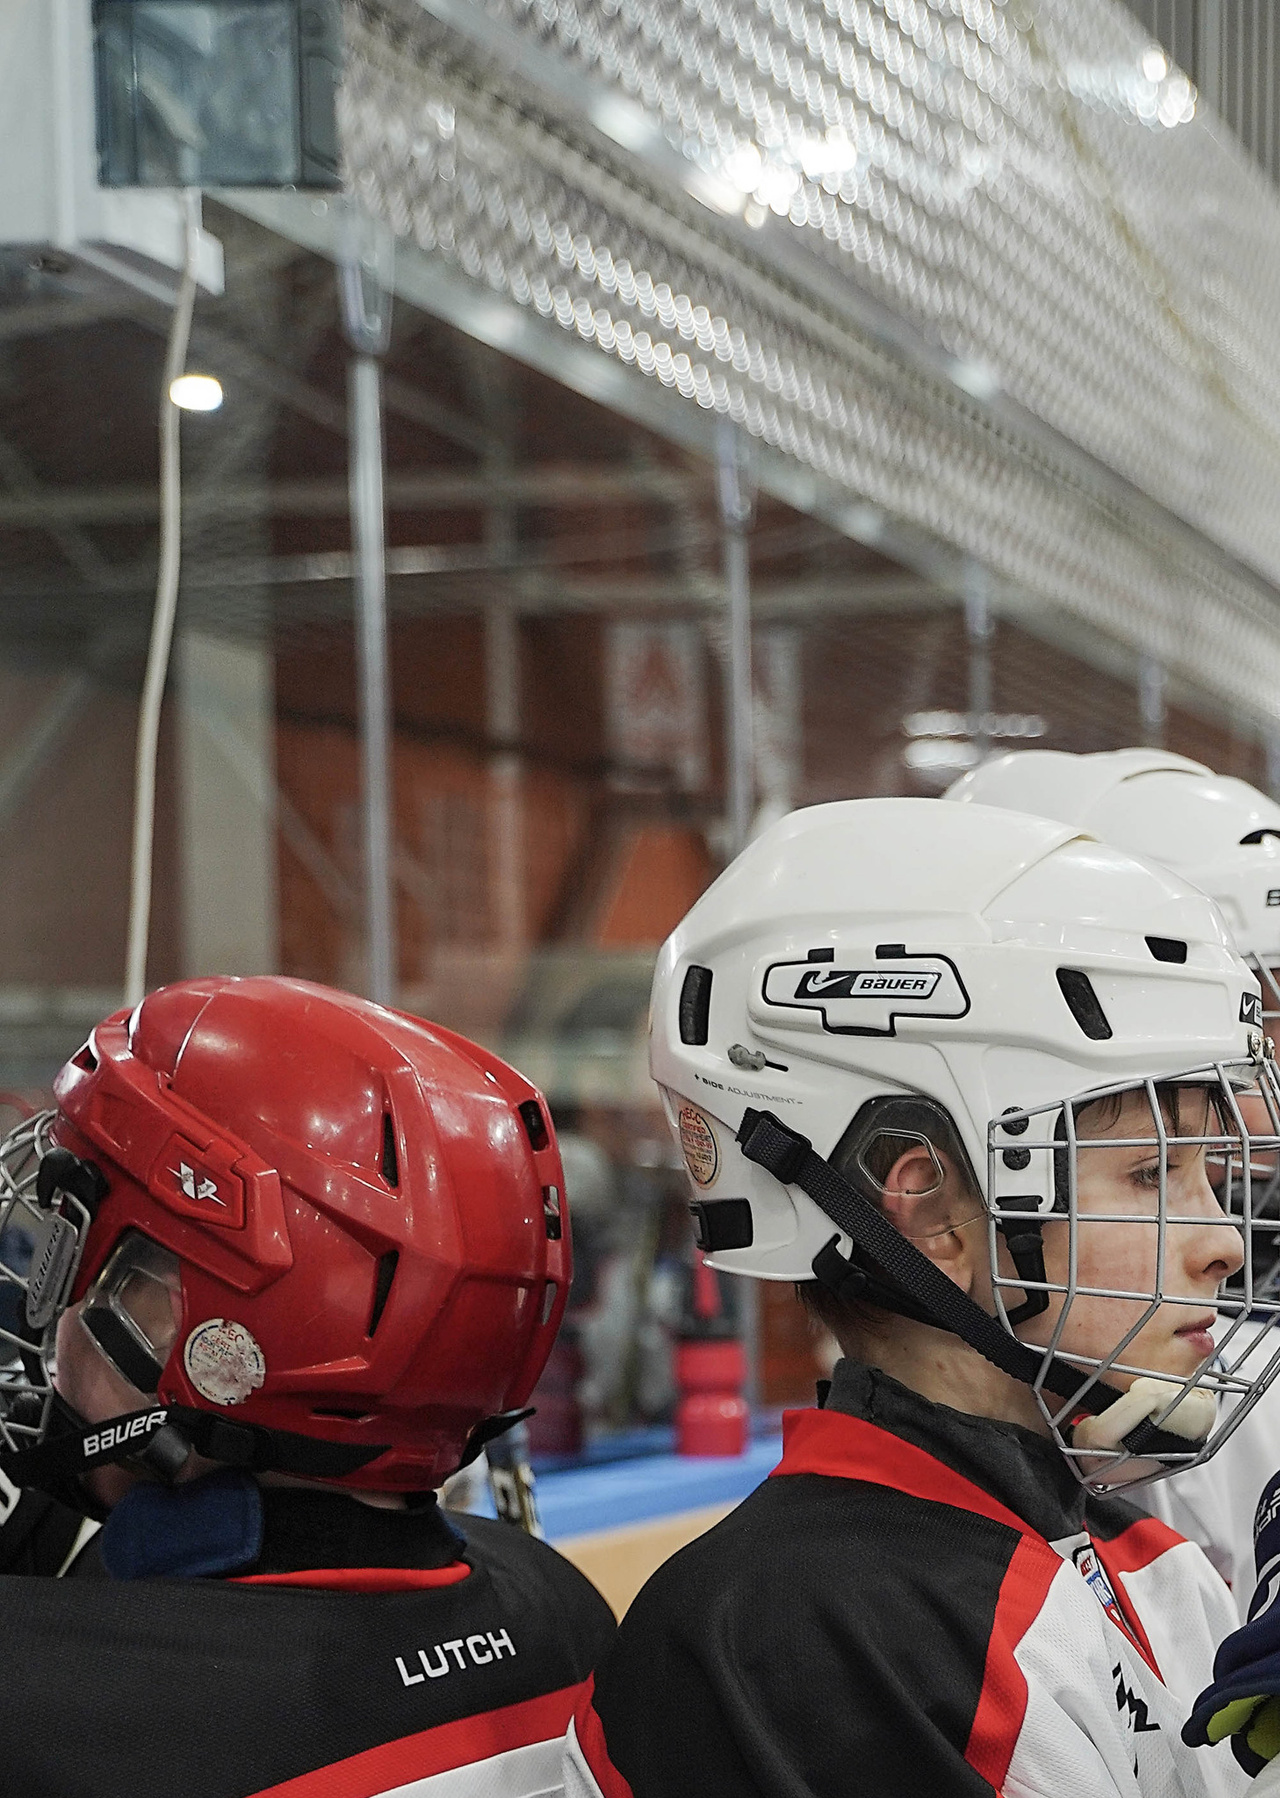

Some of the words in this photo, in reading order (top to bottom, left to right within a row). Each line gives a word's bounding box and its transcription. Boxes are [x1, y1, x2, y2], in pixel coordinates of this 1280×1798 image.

[859, 978, 927, 990] BAUER
[82, 1410, 168, 1457] BAUER
[395, 1628, 517, 1687] LUTCH
